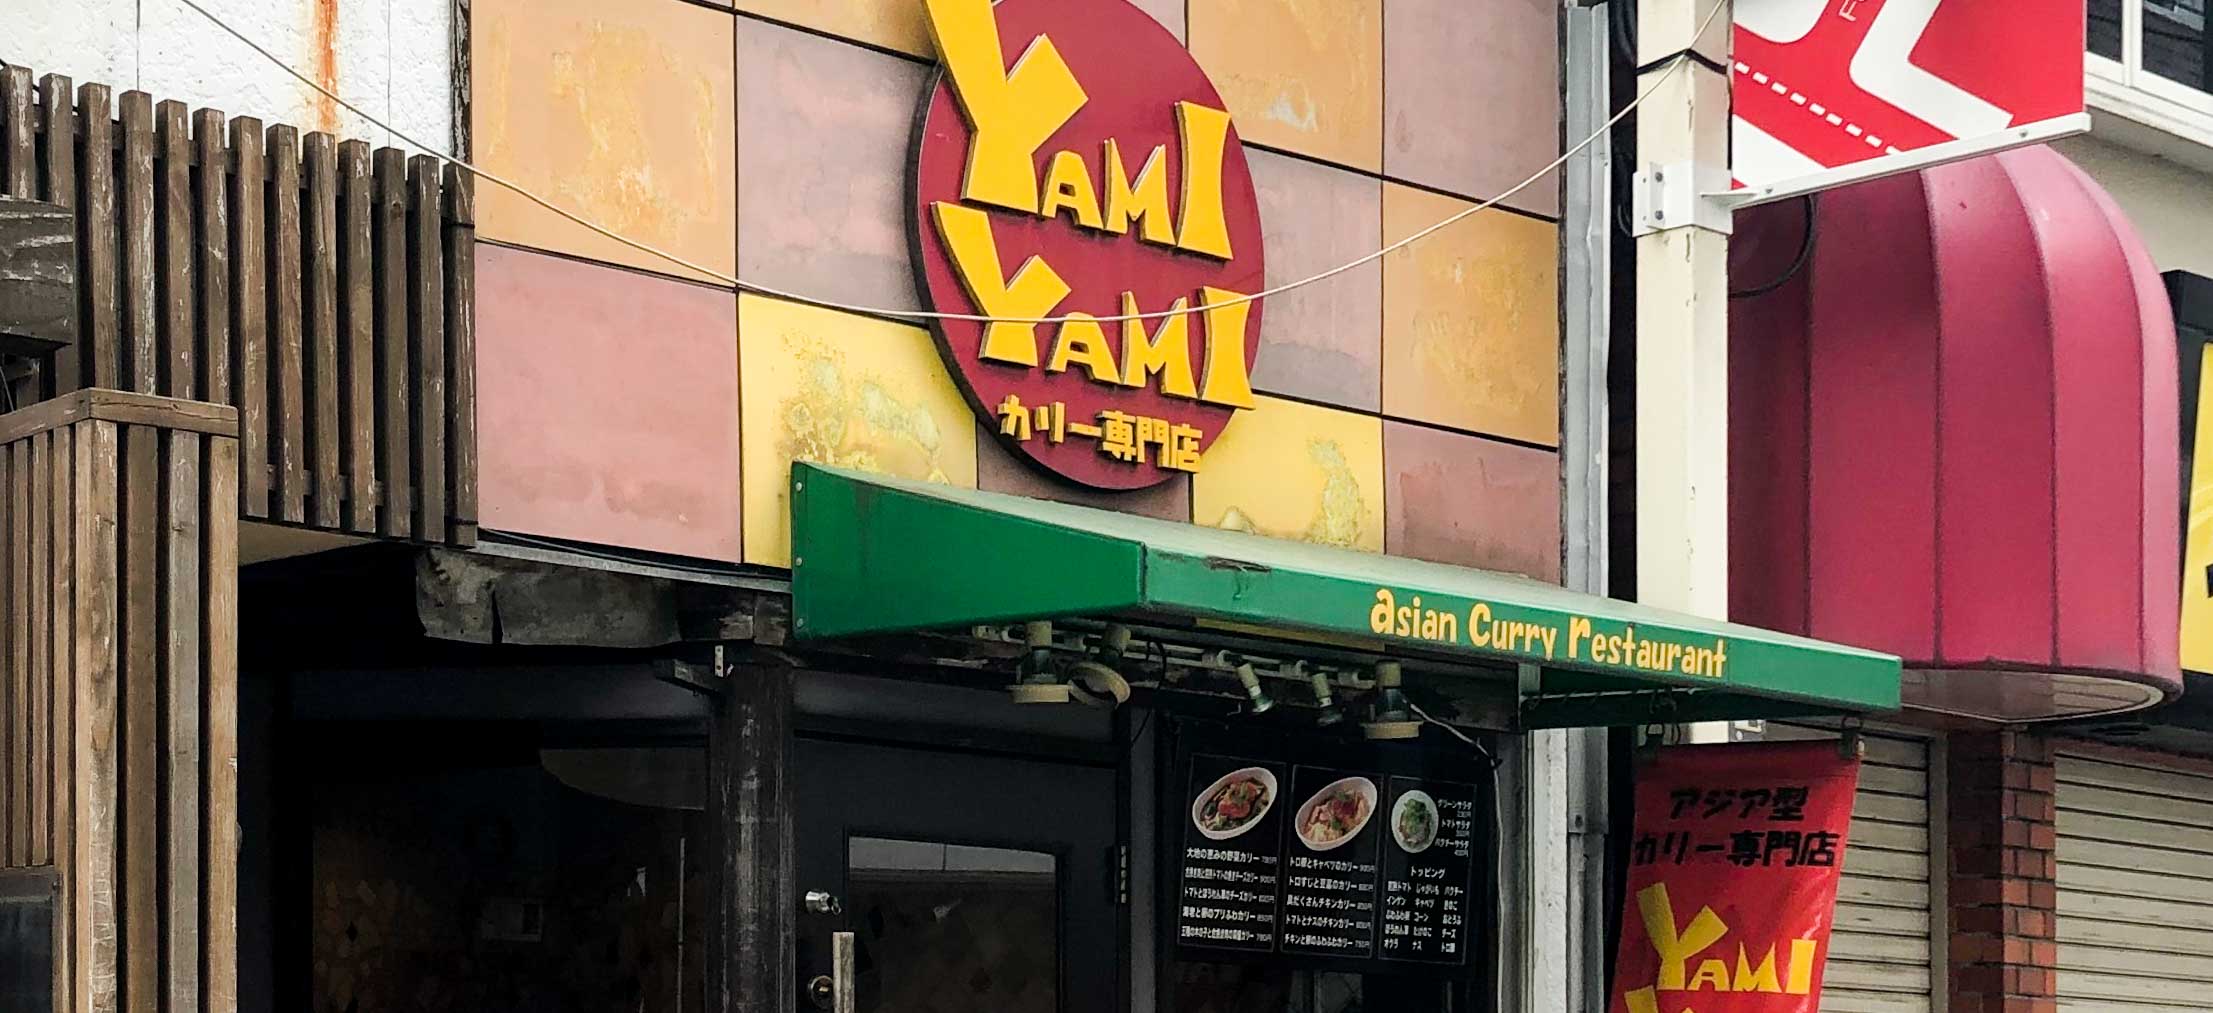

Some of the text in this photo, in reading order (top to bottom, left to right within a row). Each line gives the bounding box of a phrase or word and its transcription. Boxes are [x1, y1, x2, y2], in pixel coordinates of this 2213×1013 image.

[997, 393, 1203, 474] カリー専門店
[1468, 602, 1558, 662] Curry
[1669, 786, 1809, 822] アジア型
[1411, 866, 1446, 879] トッピング
[1635, 830, 1840, 867] カリー専門店
[1636, 882, 1818, 995] YAMI
